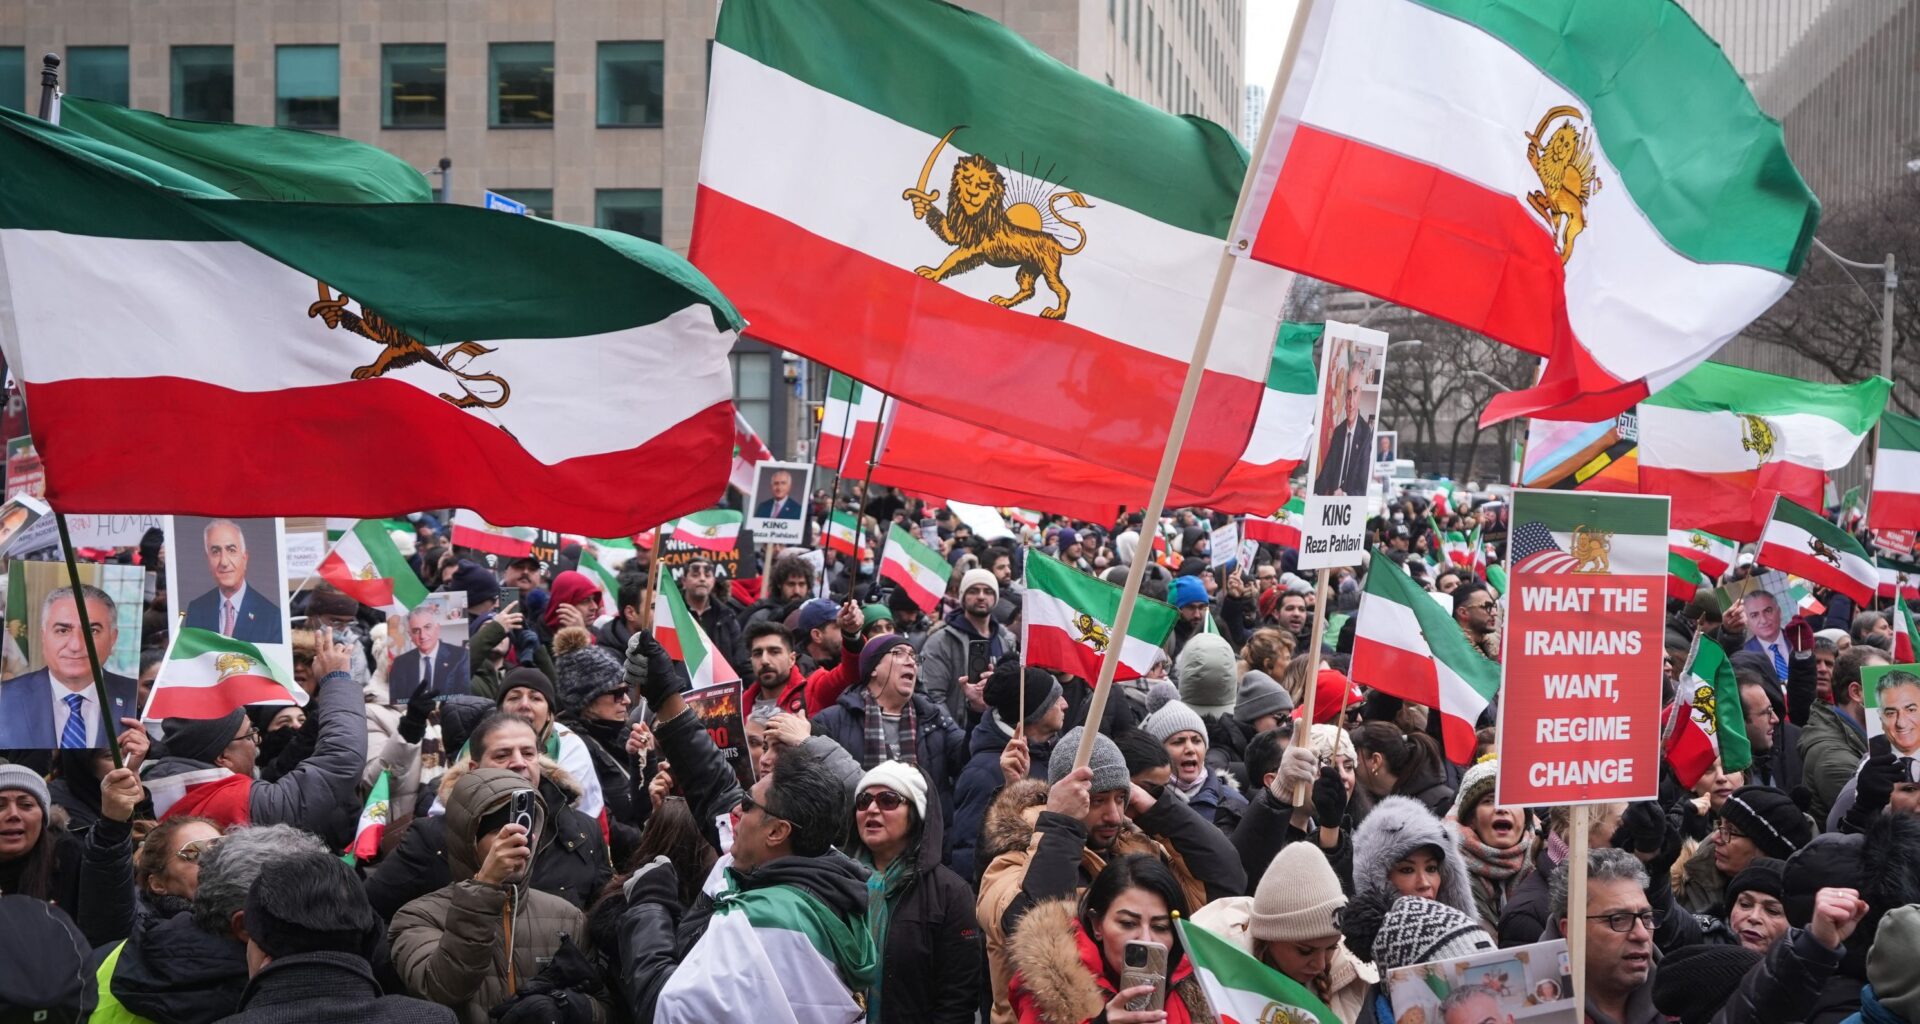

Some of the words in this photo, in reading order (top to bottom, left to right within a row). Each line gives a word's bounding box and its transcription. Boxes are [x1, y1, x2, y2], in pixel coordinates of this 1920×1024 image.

[762, 521, 788, 529] KING
[1322, 504, 1352, 526] KING
[1305, 535, 1328, 554] Reza
[1329, 533, 1362, 553] Pahlavi
[1521, 586, 1596, 612] WHAT
[1599, 587, 1648, 613] THE
[1524, 630, 1642, 656] IRANIANS
[1543, 673, 1620, 704] WANT,
[1536, 716, 1632, 743] REGIME
[1528, 758, 1634, 788] CHANGE
